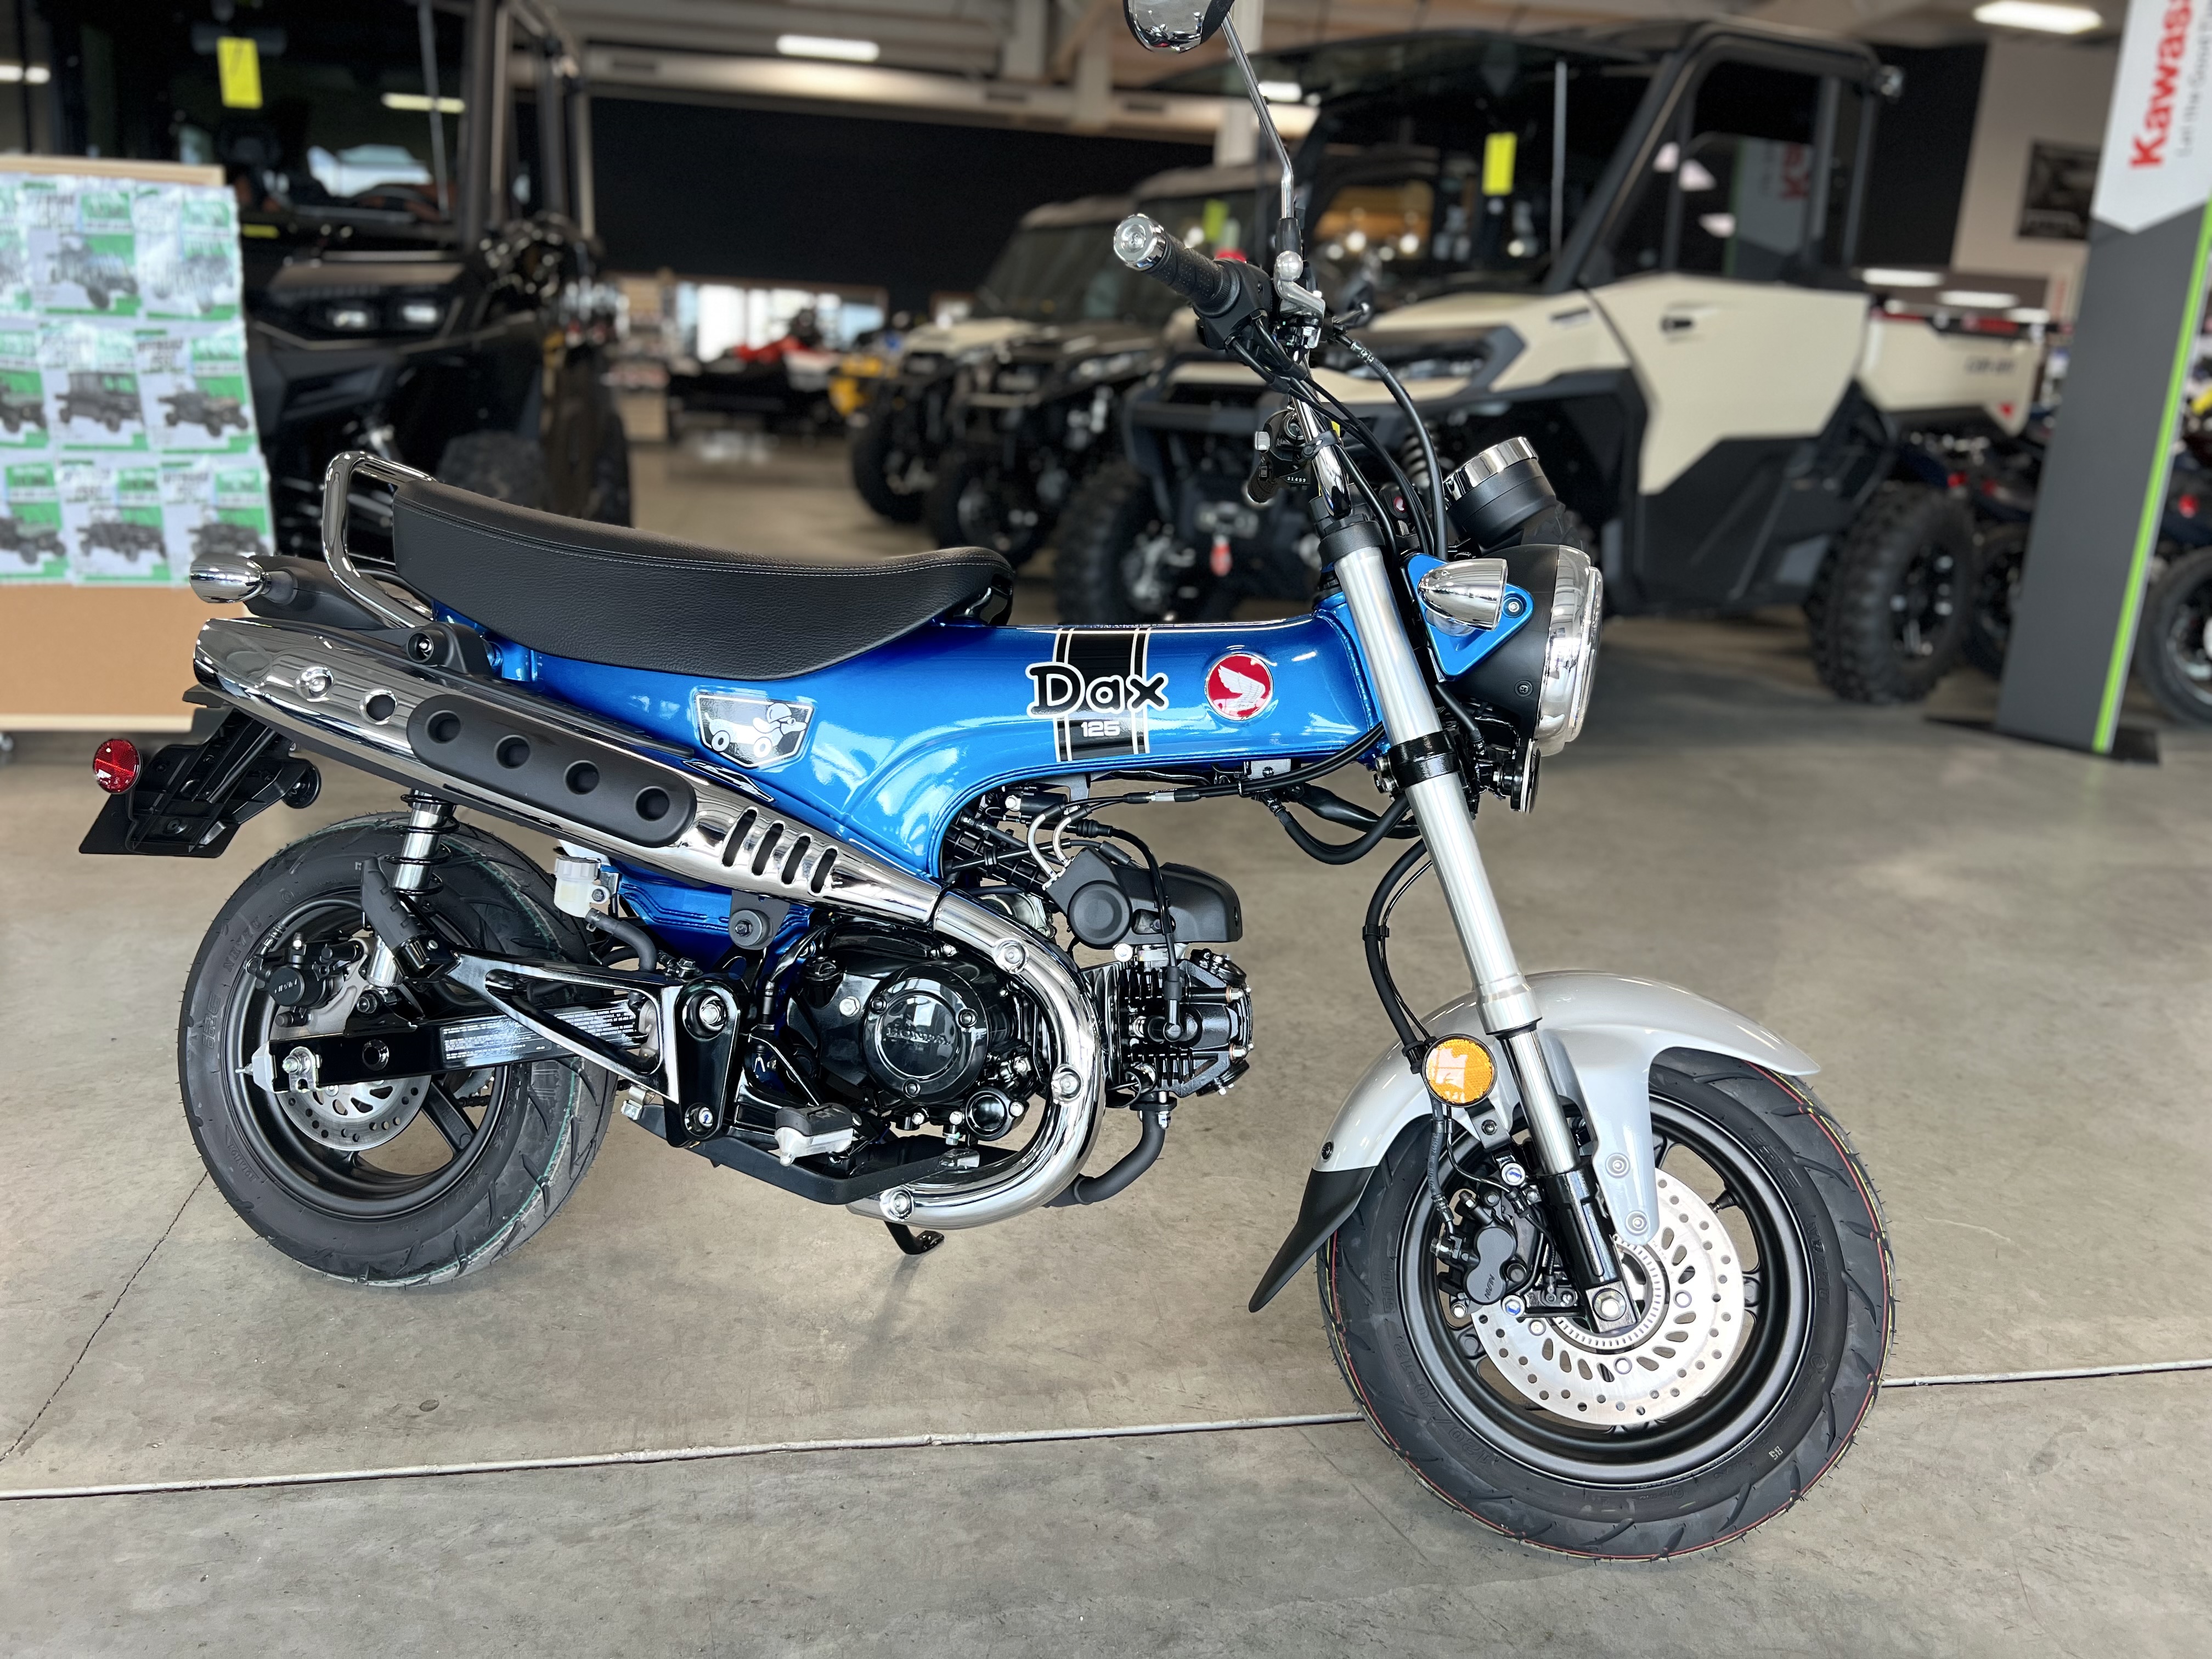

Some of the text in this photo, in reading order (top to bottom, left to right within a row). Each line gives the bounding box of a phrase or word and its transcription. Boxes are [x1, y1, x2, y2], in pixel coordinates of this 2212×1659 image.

[2129, 0, 2192, 169] Kawas
[1025, 662, 1169, 719] Dax
[1081, 721, 1121, 737] 125
